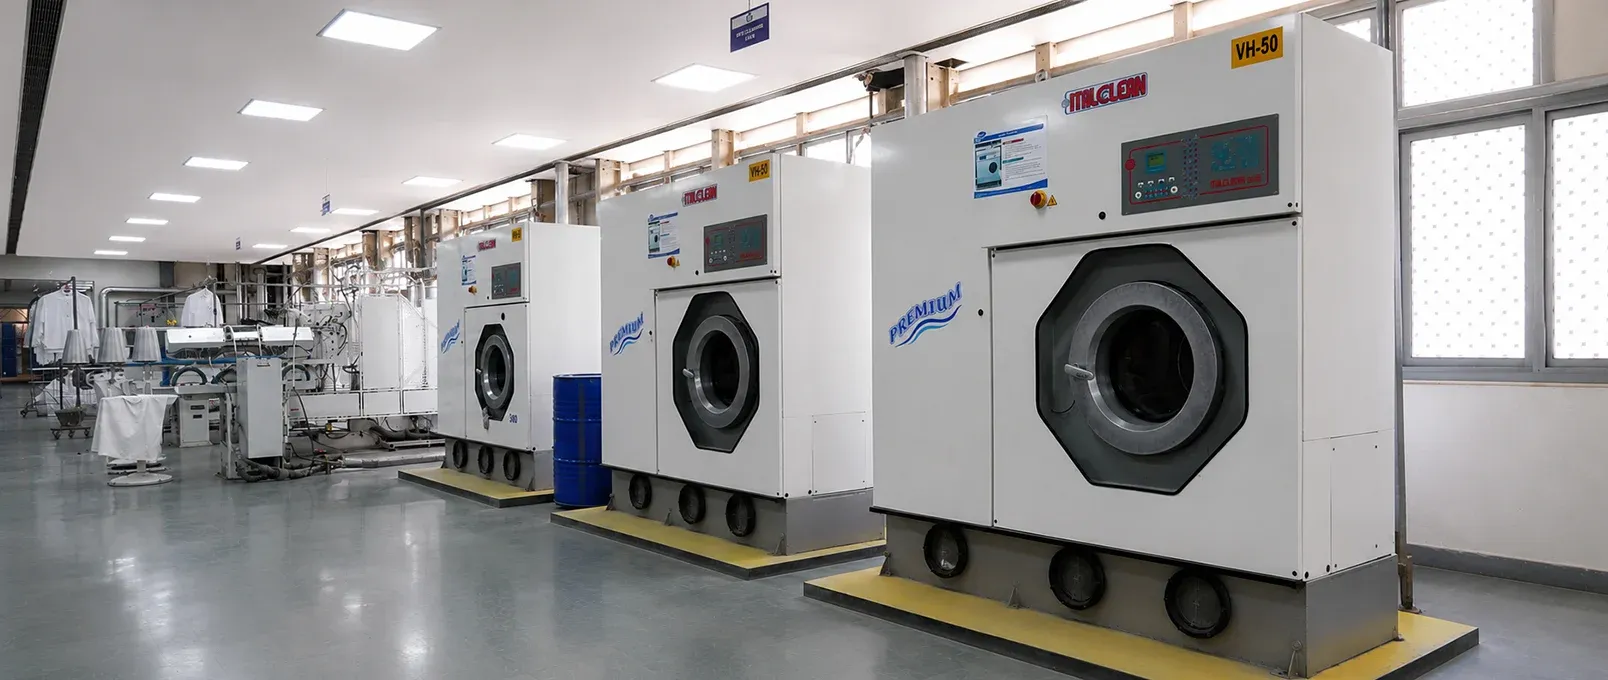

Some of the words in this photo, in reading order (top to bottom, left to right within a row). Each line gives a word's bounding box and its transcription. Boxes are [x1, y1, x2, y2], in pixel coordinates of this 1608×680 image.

[1235, 33, 1279, 61] VH-50
[1069, 74, 1146, 113] ITALCLEAN
[889, 280, 963, 345] PREMIUM
